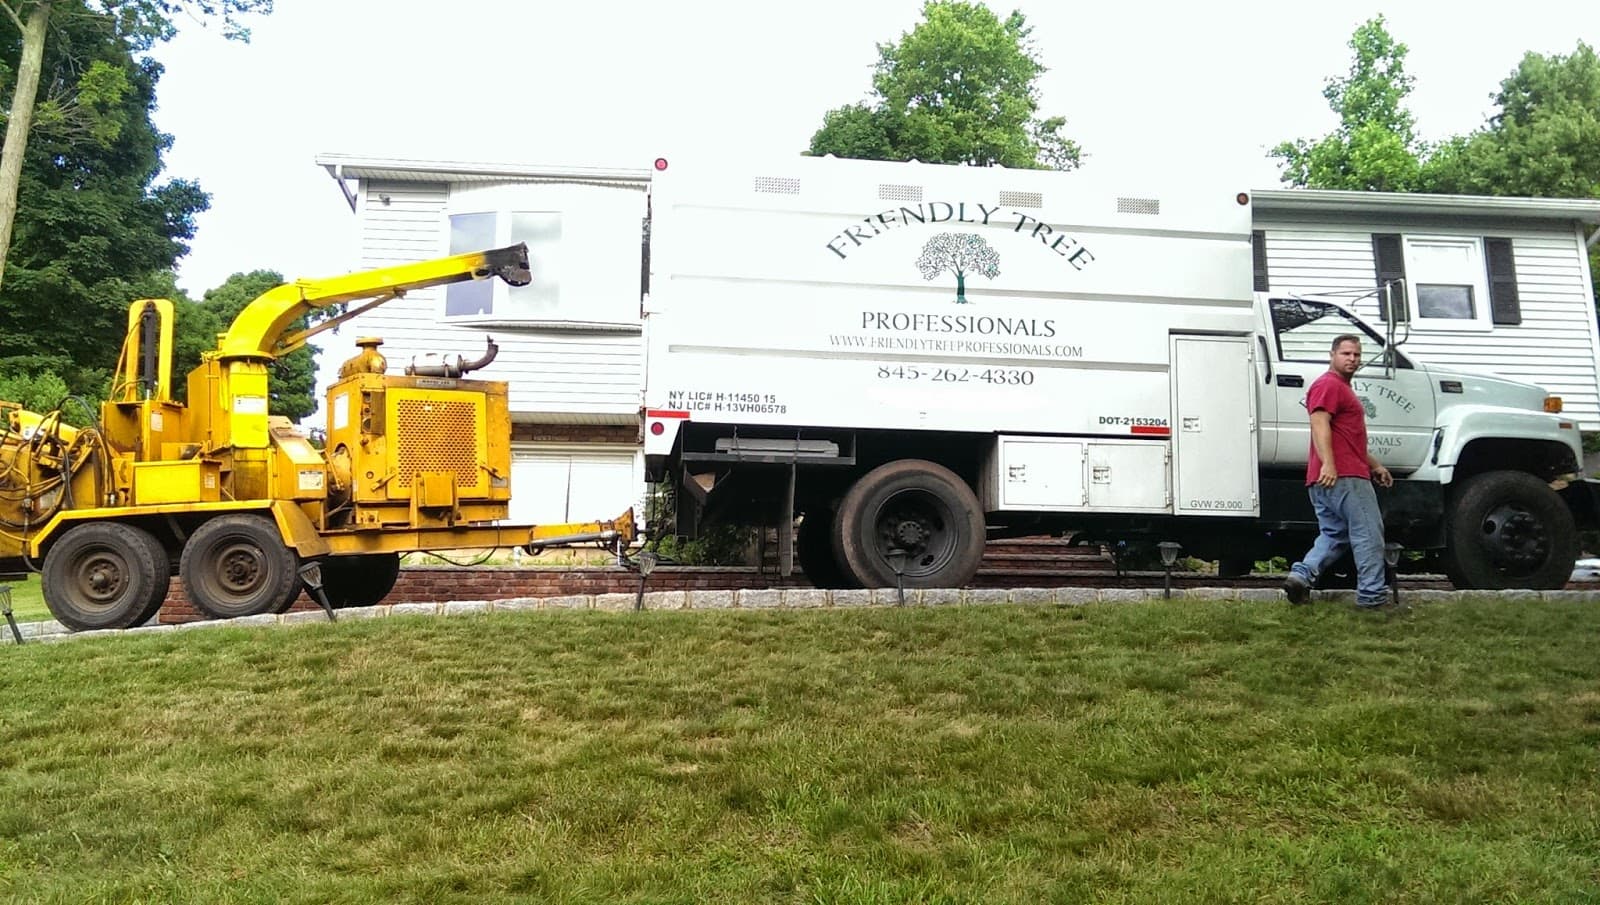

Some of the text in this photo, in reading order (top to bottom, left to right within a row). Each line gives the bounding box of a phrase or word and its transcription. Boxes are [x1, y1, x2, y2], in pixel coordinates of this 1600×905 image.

[826, 202, 1095, 271] FRIENDLY TREE
[862, 311, 1056, 338] PROFESSIONALS
[829, 334, 1083, 358] WWW.FRIENDLYTREEPROFESSIONALS.COM
[877, 365, 1034, 386] 845-262-4330
[668, 401, 787, 414] NJ LIC# H-13VH06578
[669, 391, 776, 404] NY LIC# H-11450 15
[1377, 385, 1415, 413] TREE
[1098, 416, 1168, 426] DOT-2153204
[1191, 499, 1212, 509] GVW
